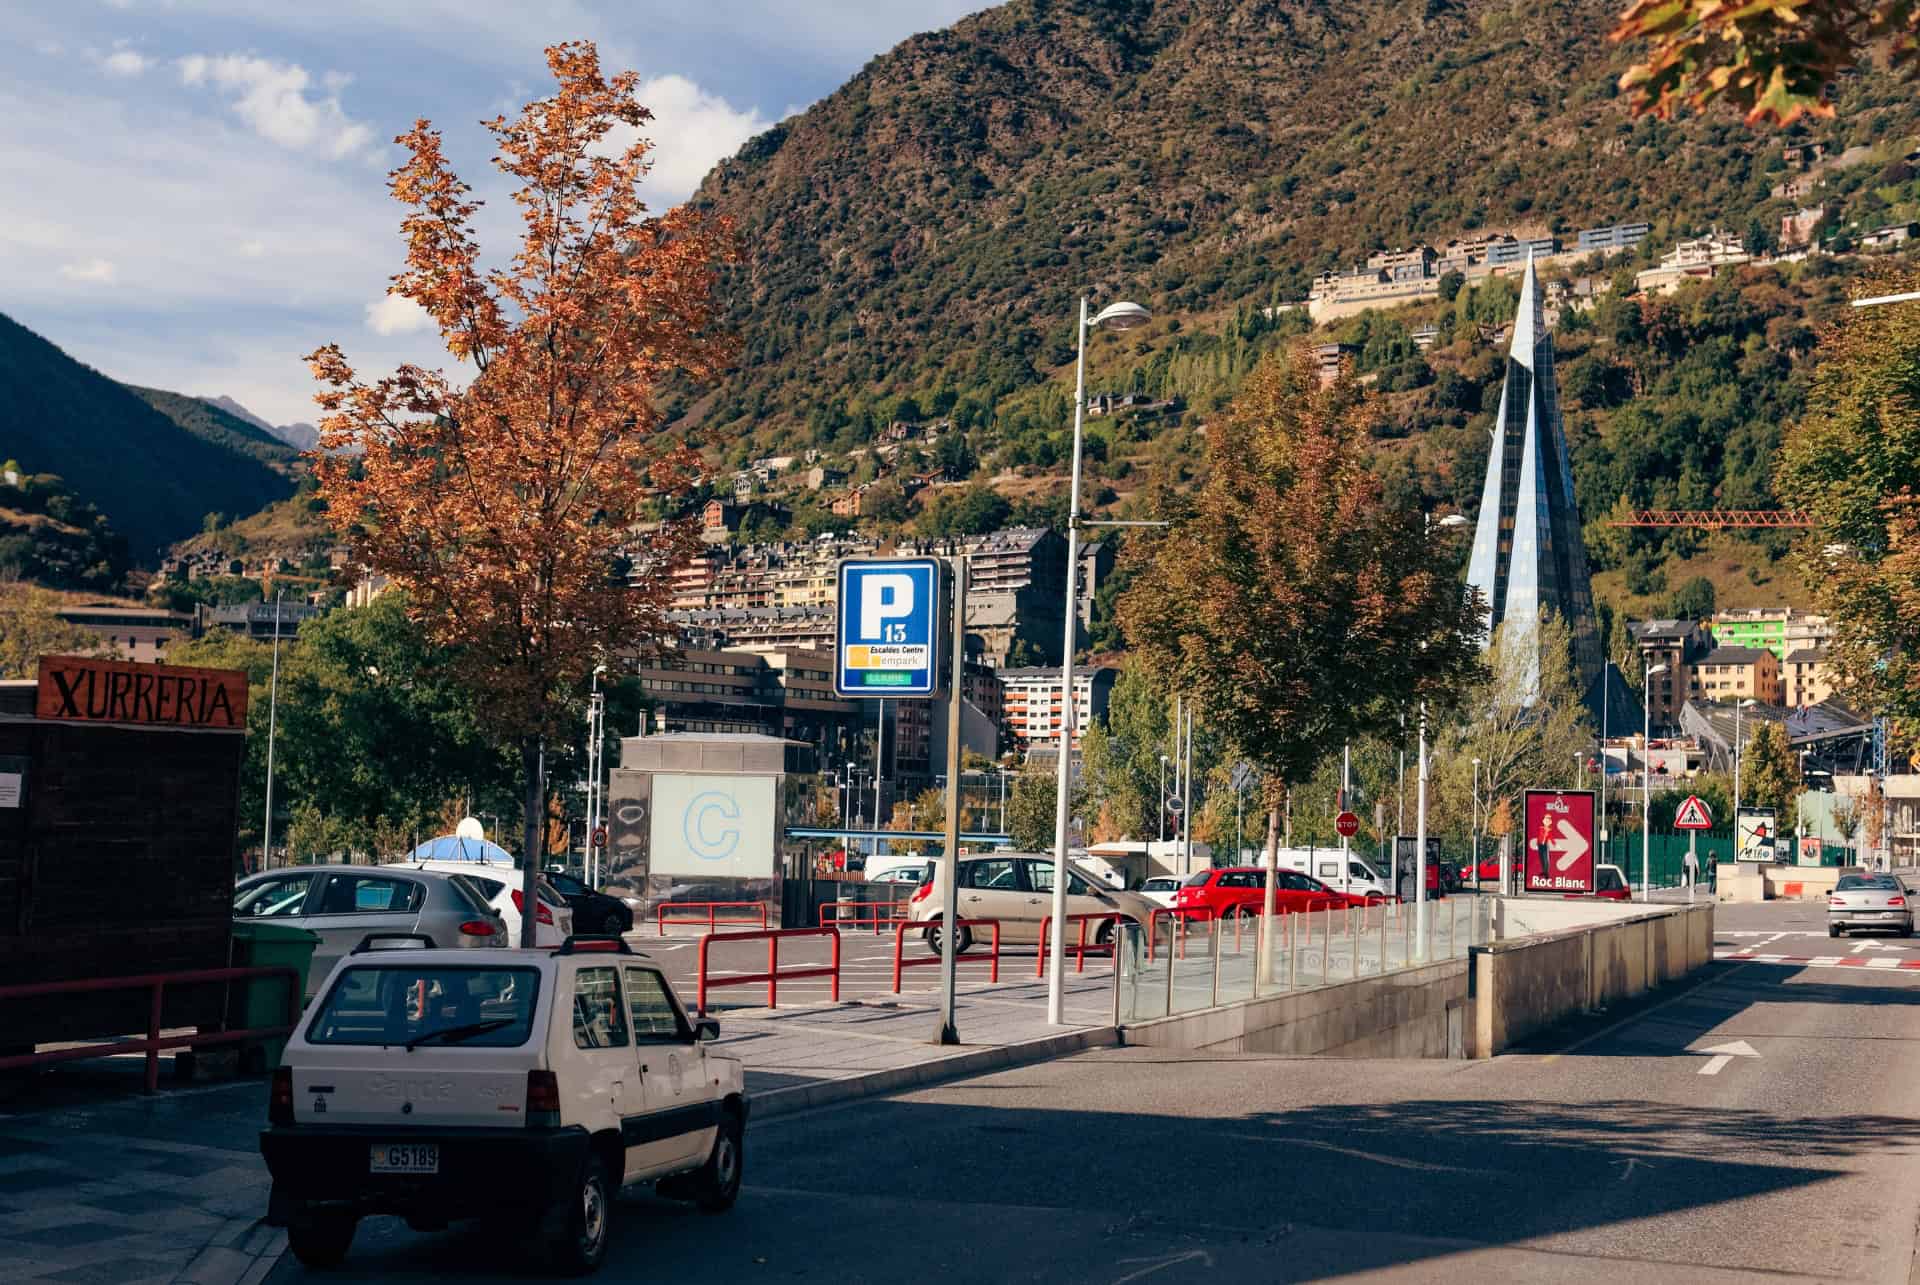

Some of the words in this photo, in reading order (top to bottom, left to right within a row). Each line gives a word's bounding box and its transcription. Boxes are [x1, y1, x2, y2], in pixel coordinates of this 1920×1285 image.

[860, 574, 914, 640] P
[884, 623, 907, 643] 13
[870, 646, 900, 654] Escaldes
[902, 646, 924, 654] Centre
[881, 656, 918, 667] empark
[51, 668, 235, 725] XURRERIA
[683, 790, 741, 861] C
[1337, 820, 1358, 829] STOP
[1532, 875, 1552, 888] Roc
[1555, 876, 1585, 889] Blanc
[389, 1146, 435, 1167] G5189
